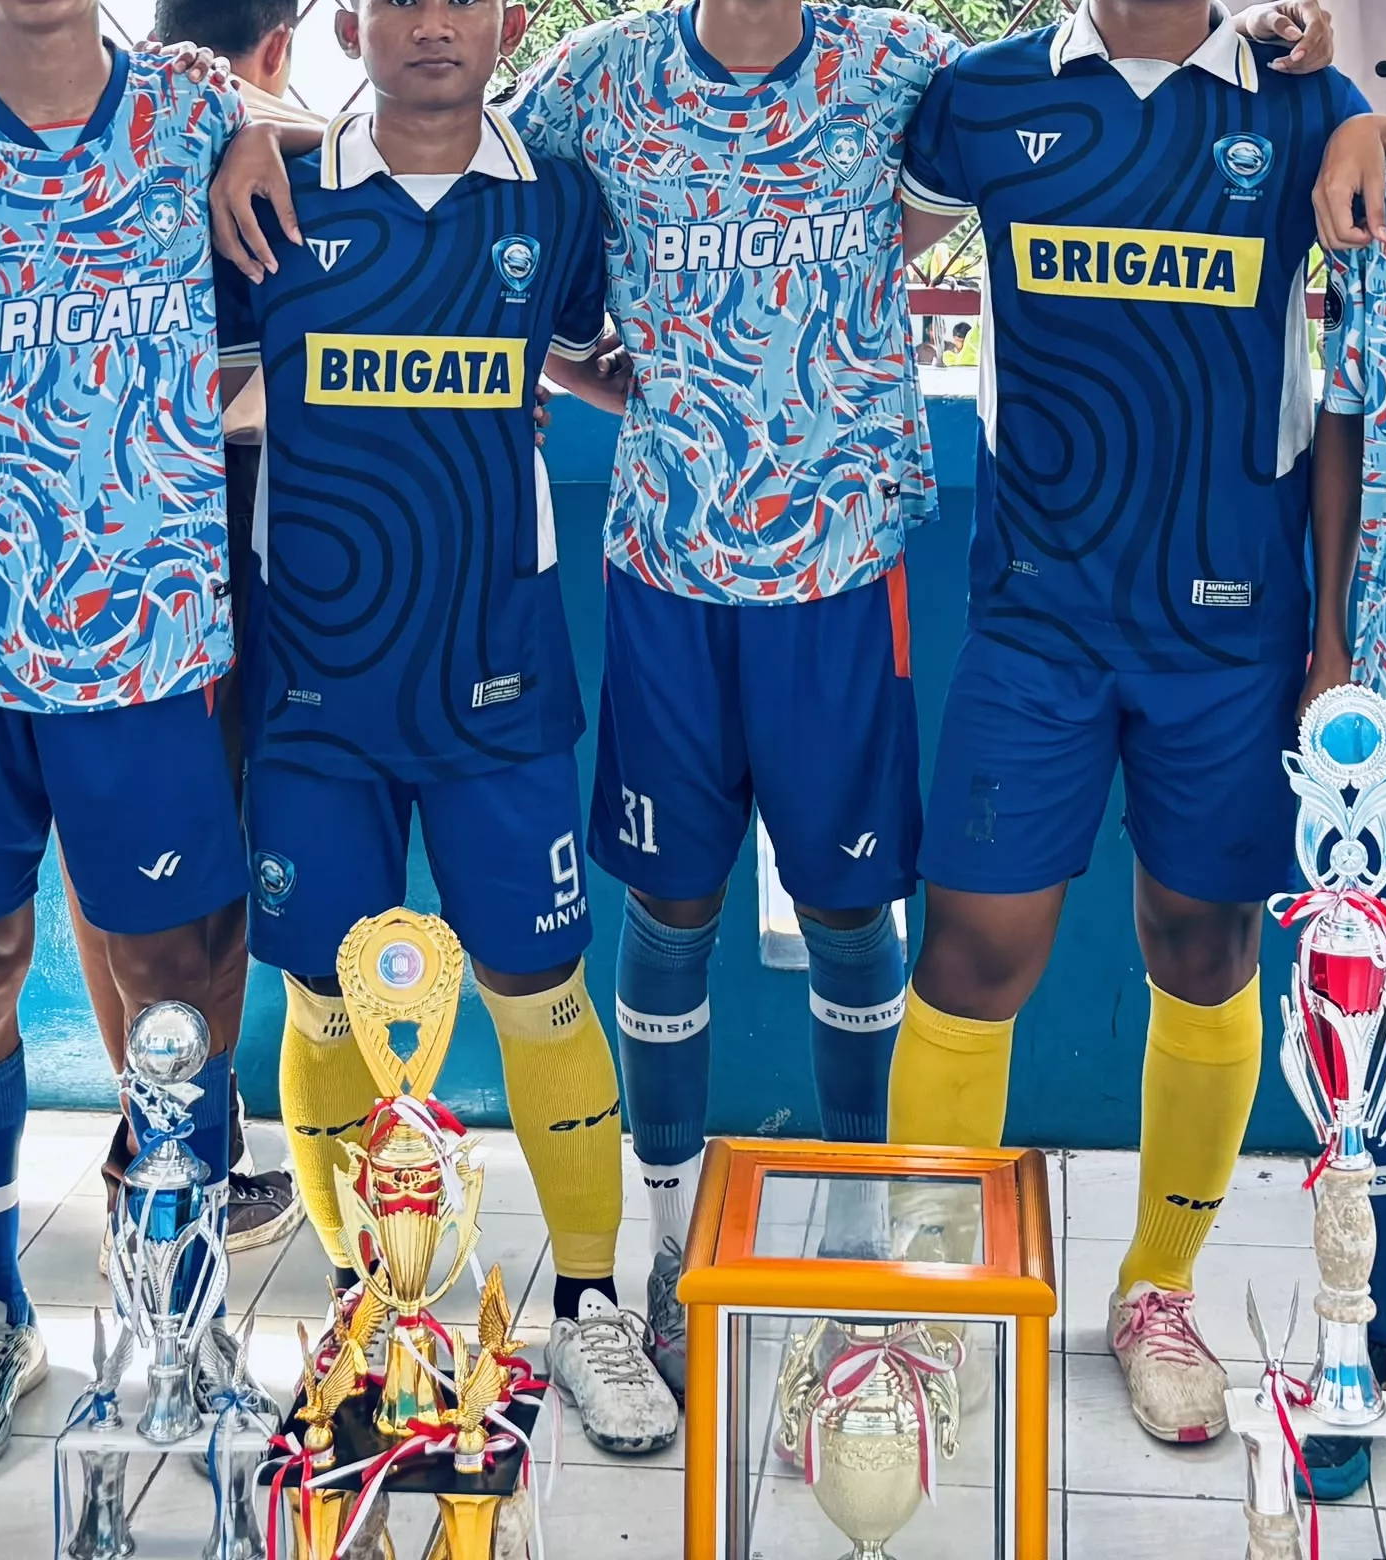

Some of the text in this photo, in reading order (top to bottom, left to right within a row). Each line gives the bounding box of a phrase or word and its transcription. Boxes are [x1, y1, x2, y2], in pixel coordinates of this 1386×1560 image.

[655, 207, 866, 273] BRIGATA
[1029, 238, 1236, 293] BRIGATA
[320, 348, 511, 394] BRIGATA
[1206, 583, 1248, 592] AUTHENTIC
[485, 676, 518, 690] AUTHENTIC
[619, 782, 659, 855] 31
[549, 830, 580, 908] 9
[535, 896, 587, 934] MNVR
